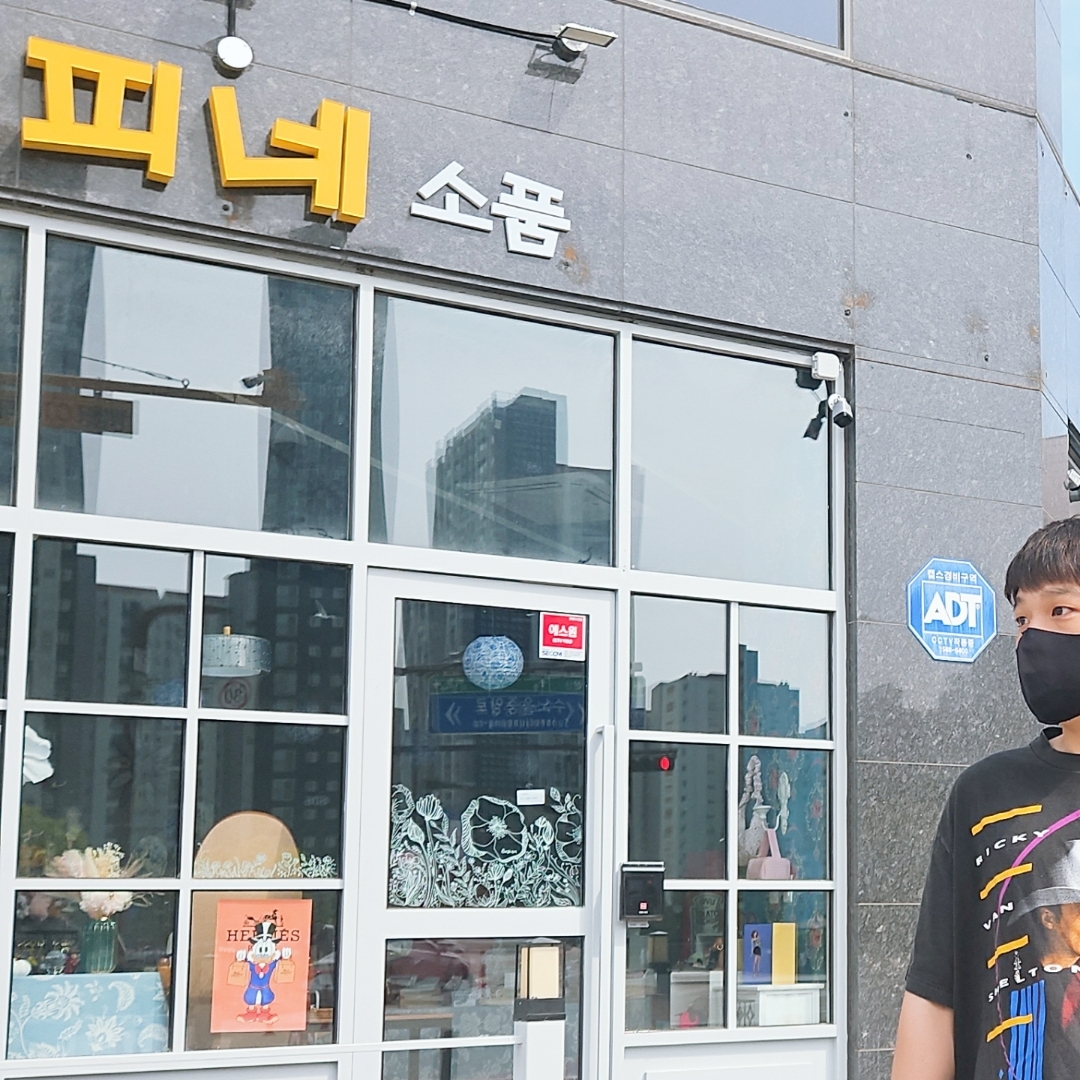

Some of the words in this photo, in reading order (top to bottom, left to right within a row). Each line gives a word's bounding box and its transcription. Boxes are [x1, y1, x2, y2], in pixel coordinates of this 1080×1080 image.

[22, 36, 371, 224] 피네
[410, 160, 572, 259] 소품
[924, 590, 981, 628] ADT
[548, 624, 578, 639] 에스원
[975, 829, 1049, 867] RICKY
[982, 901, 1015, 931] VAN
